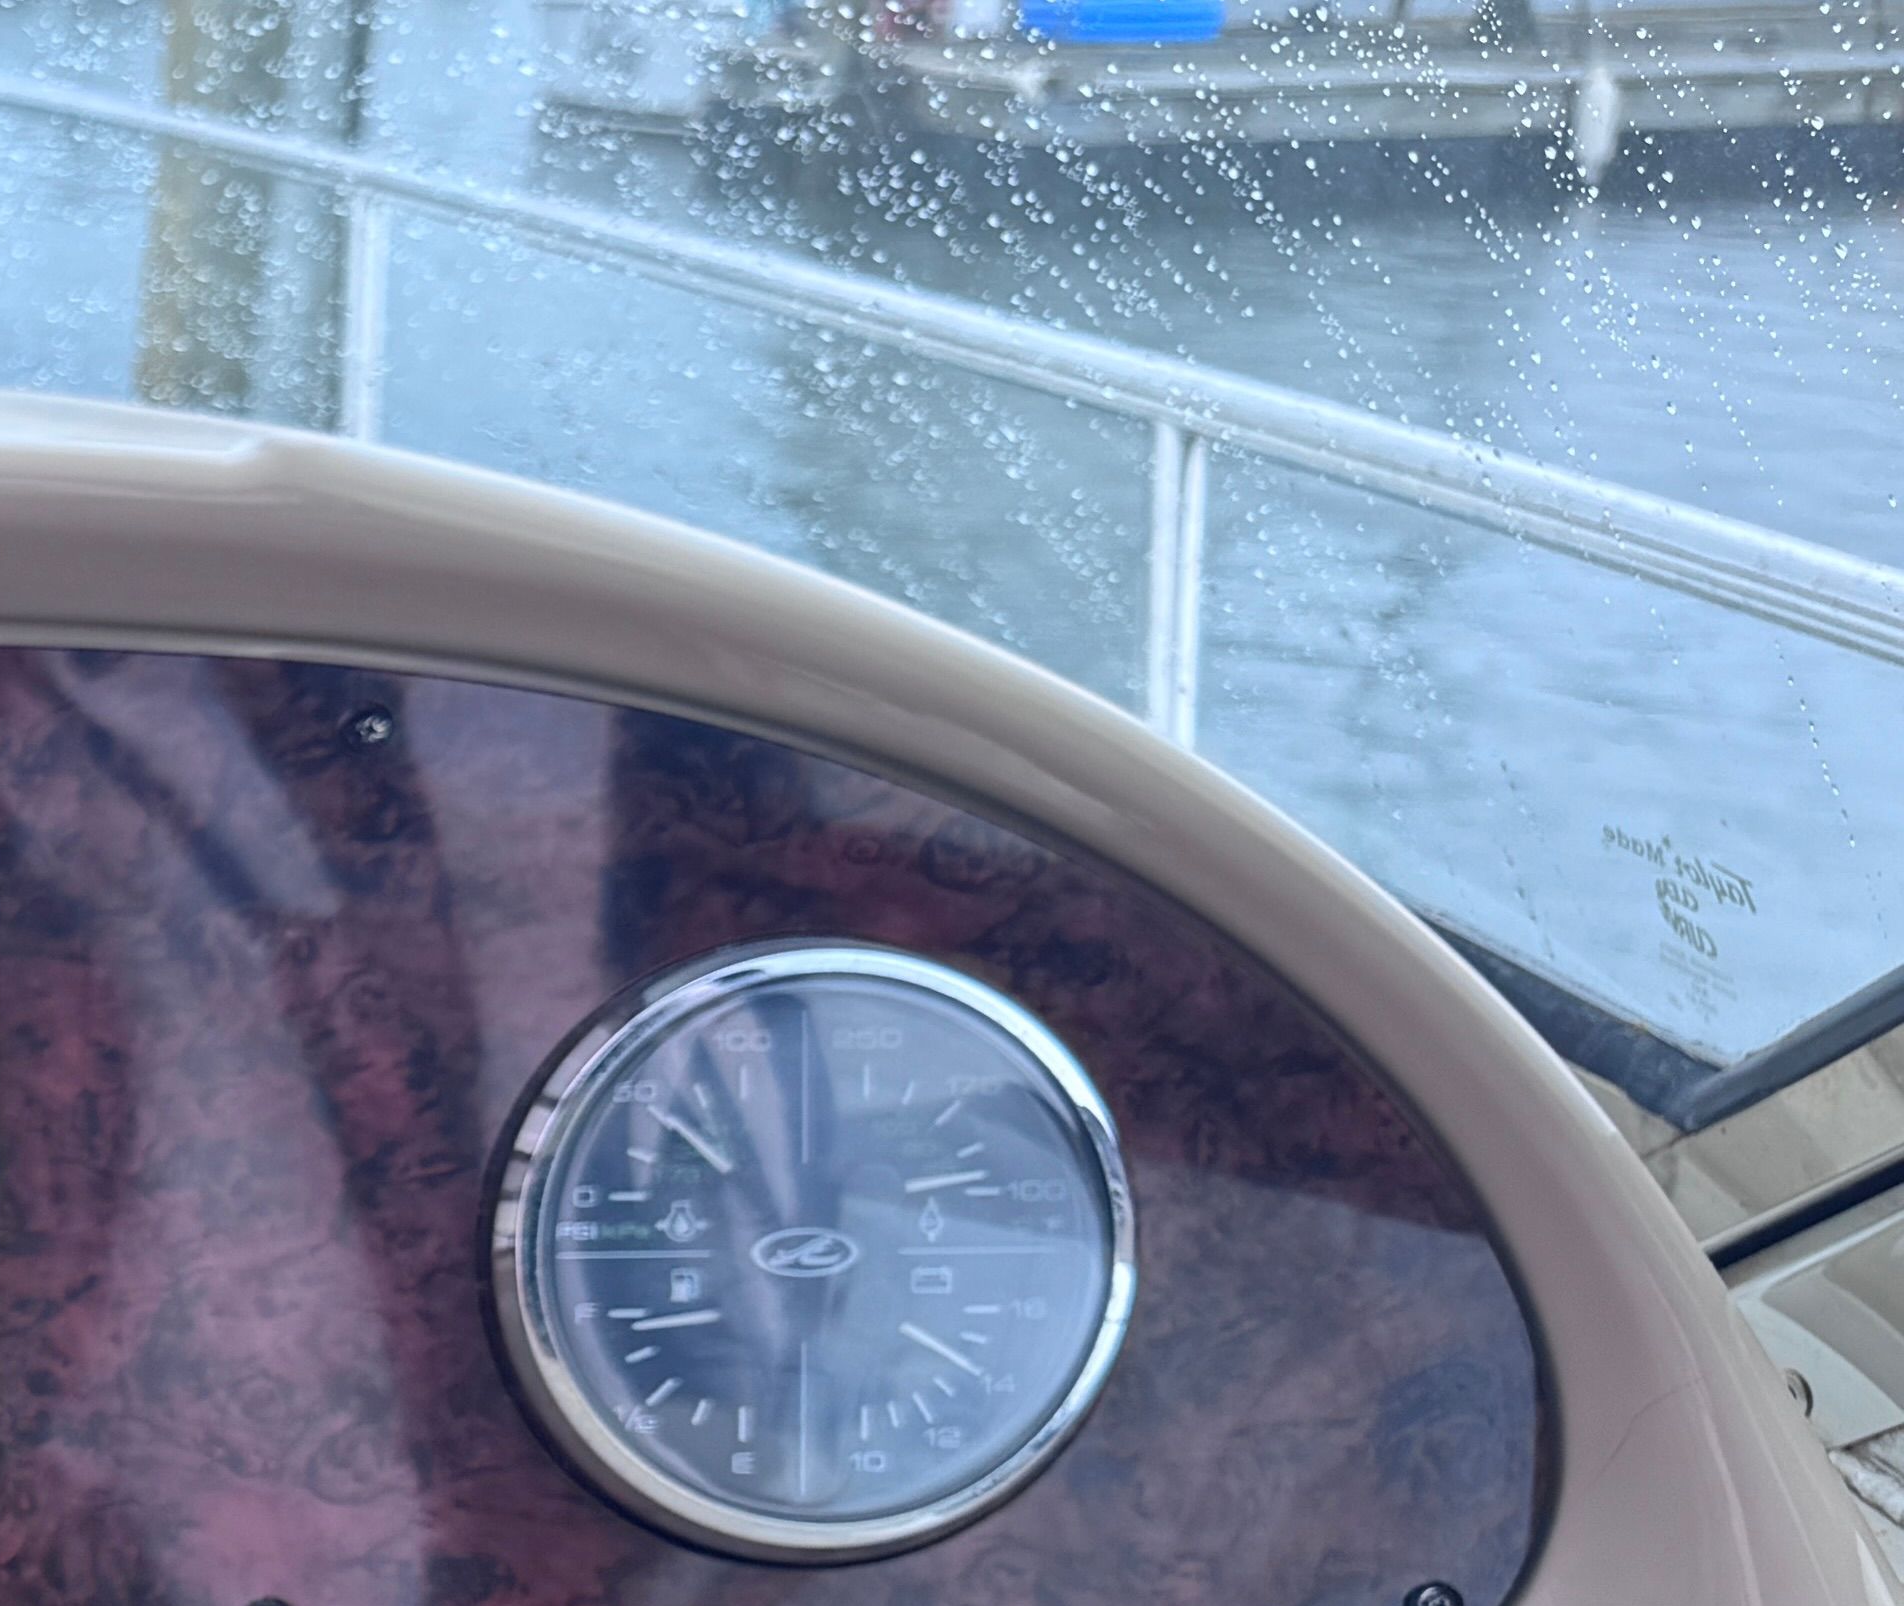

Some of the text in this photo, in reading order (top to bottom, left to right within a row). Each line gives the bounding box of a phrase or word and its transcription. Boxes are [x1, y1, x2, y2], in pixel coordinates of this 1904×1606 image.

[713, 1029, 774, 1053] 100
[572, 1187, 596, 1208] 0
[731, 1453, 755, 1475] E
[849, 1452, 886, 1474] 10
